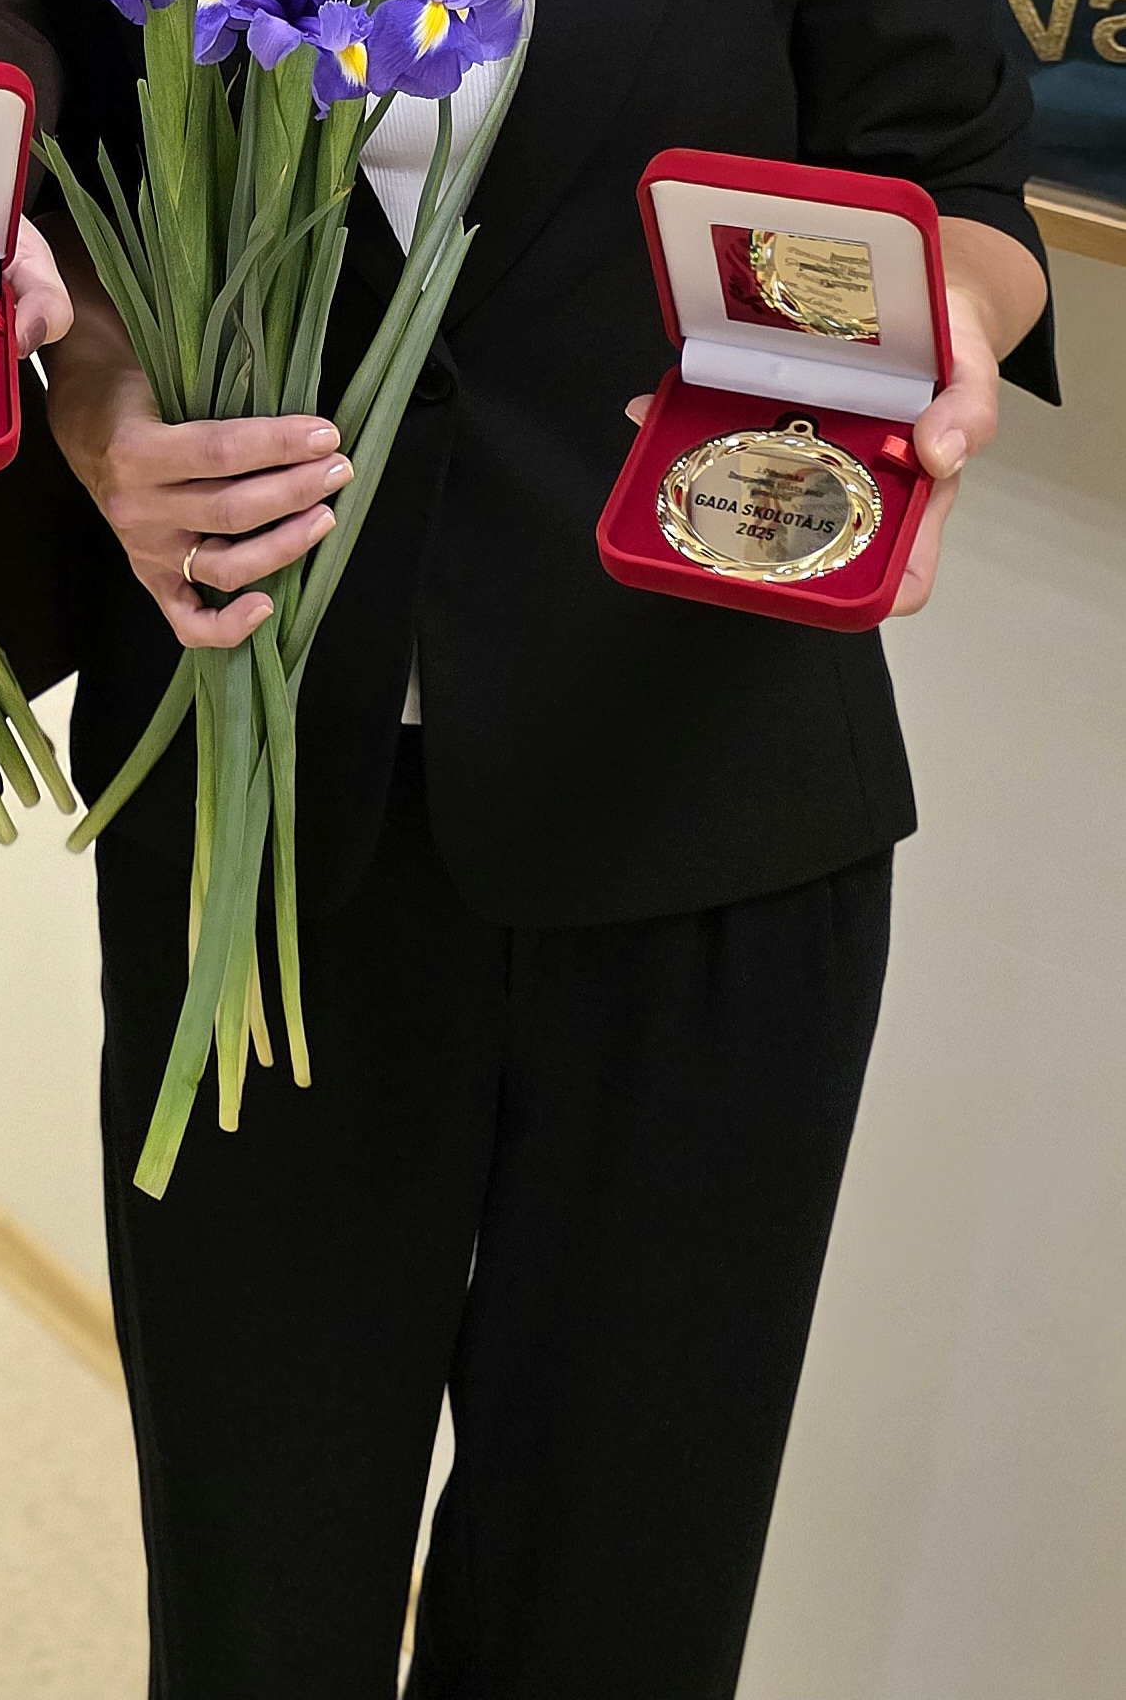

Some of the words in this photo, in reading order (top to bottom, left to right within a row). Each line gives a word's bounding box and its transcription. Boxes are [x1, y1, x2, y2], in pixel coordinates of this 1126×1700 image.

[695, 493, 737, 514] GADA
[742, 503, 835, 534] SKOLOTĀJS
[736, 522, 775, 541] 2025
